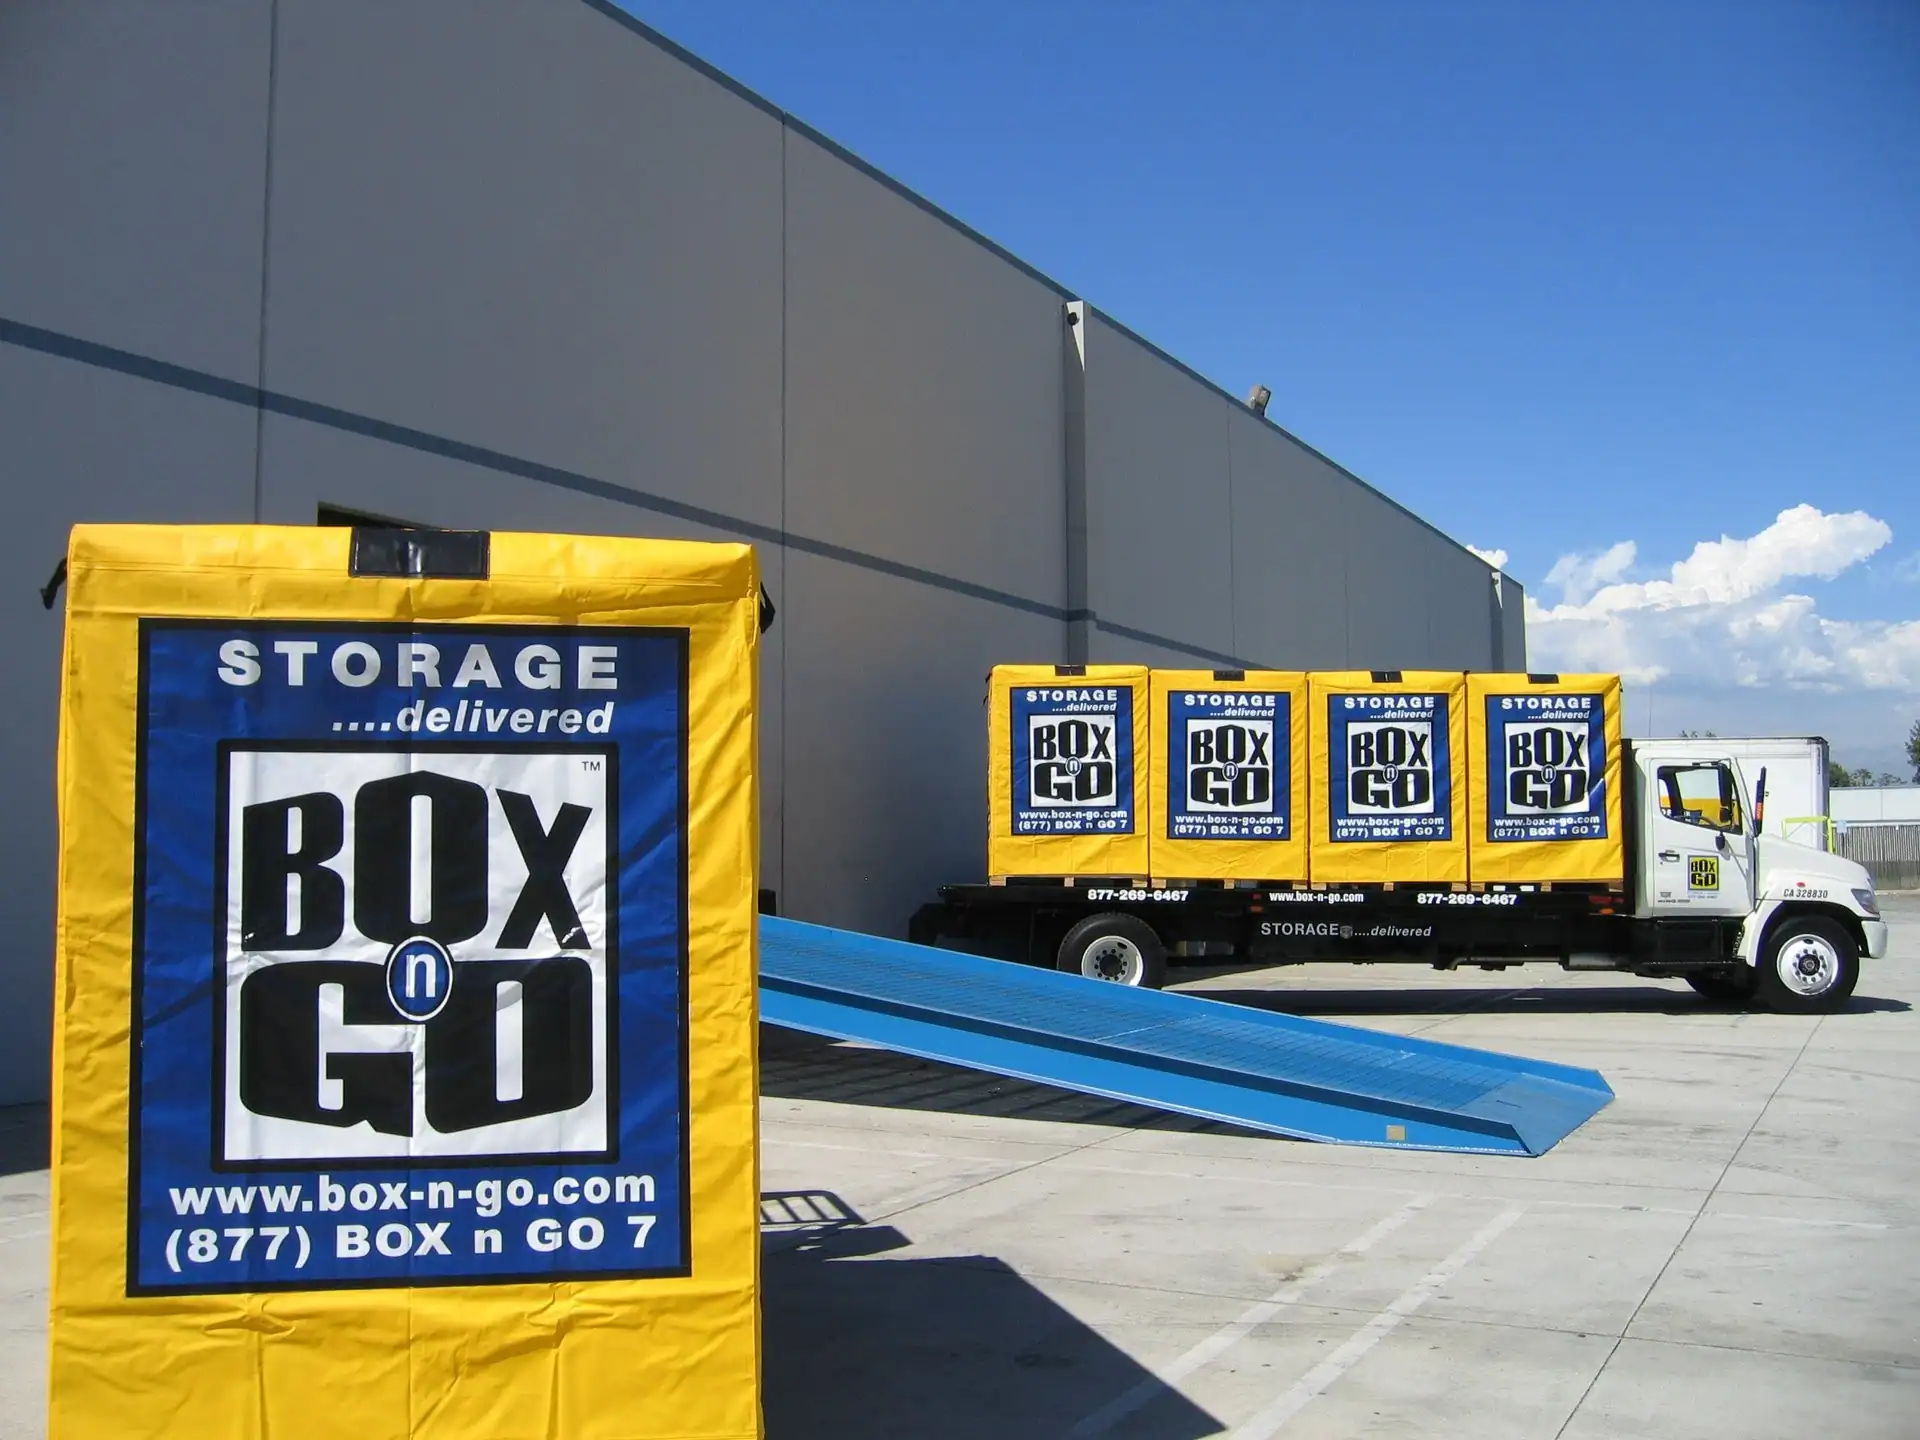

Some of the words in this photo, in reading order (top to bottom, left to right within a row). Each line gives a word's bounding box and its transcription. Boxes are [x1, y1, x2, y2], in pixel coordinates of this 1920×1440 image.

[218, 640, 619, 691] STORAGE
[1026, 690, 1117, 702] STORAGE
[1184, 694, 1275, 706] STORAGE
[1345, 697, 1434, 708] STORAGE
[1502, 698, 1591, 709] STORAGE
[1034, 720, 1111, 760] BOX
[1191, 724, 1269, 765] BOX
[1351, 727, 1428, 767] BOX
[1509, 727, 1585, 768] BOX
[1034, 762, 1112, 801] GO
[1191, 767, 1269, 807] GO
[1351, 769, 1429, 808] GO
[1510, 769, 1586, 809] GO
[1019, 810, 1127, 820] www.box-n-go.com
[1175, 815, 1283, 825] www.box-n-go.com
[1495, 816, 1599, 826] www.box-n-go.com
[1019, 821, 1050, 831] (877)
[1055, 821, 1081, 829] BOX
[1098, 820, 1115, 828] GO
[1121, 820, 1127, 828] 7
[1337, 817, 1444, 827] www.box-n-go.com
[1175, 825, 1206, 835] (877)
[1211, 826, 1237, 834] BOX
[1254, 826, 1271, 834] GO
[1276, 826, 1283, 834] 7
[1337, 828, 1368, 838] (877)
[1373, 828, 1399, 836] BOX
[1438, 827, 1444, 835] 7
[1494, 828, 1525, 838] (877)
[1529, 828, 1556, 836] BOX
[1572, 826, 1588, 834] GO
[1593, 825, 1600, 833] 7
[241, 770, 592, 951] BOX
[1087, 889, 1189, 902] 877-269-6467
[1269, 891, 1364, 904] www.box-n-go.com
[1417, 893, 1517, 905] 877-269-6467
[1783, 888, 1794, 898] CA
[1796, 889, 1828, 898] 328830
[1260, 922, 1339, 937] STORAGE
[239, 956, 593, 1138] GO
[169, 1171, 655, 1216] www.box-n-go.com
[165, 1227, 311, 1272] (877)
[336, 1222, 451, 1258] BOX
[474, 1229, 502, 1254] n
[528, 1218, 606, 1252] GO
[628, 1216, 656, 1248] 7
